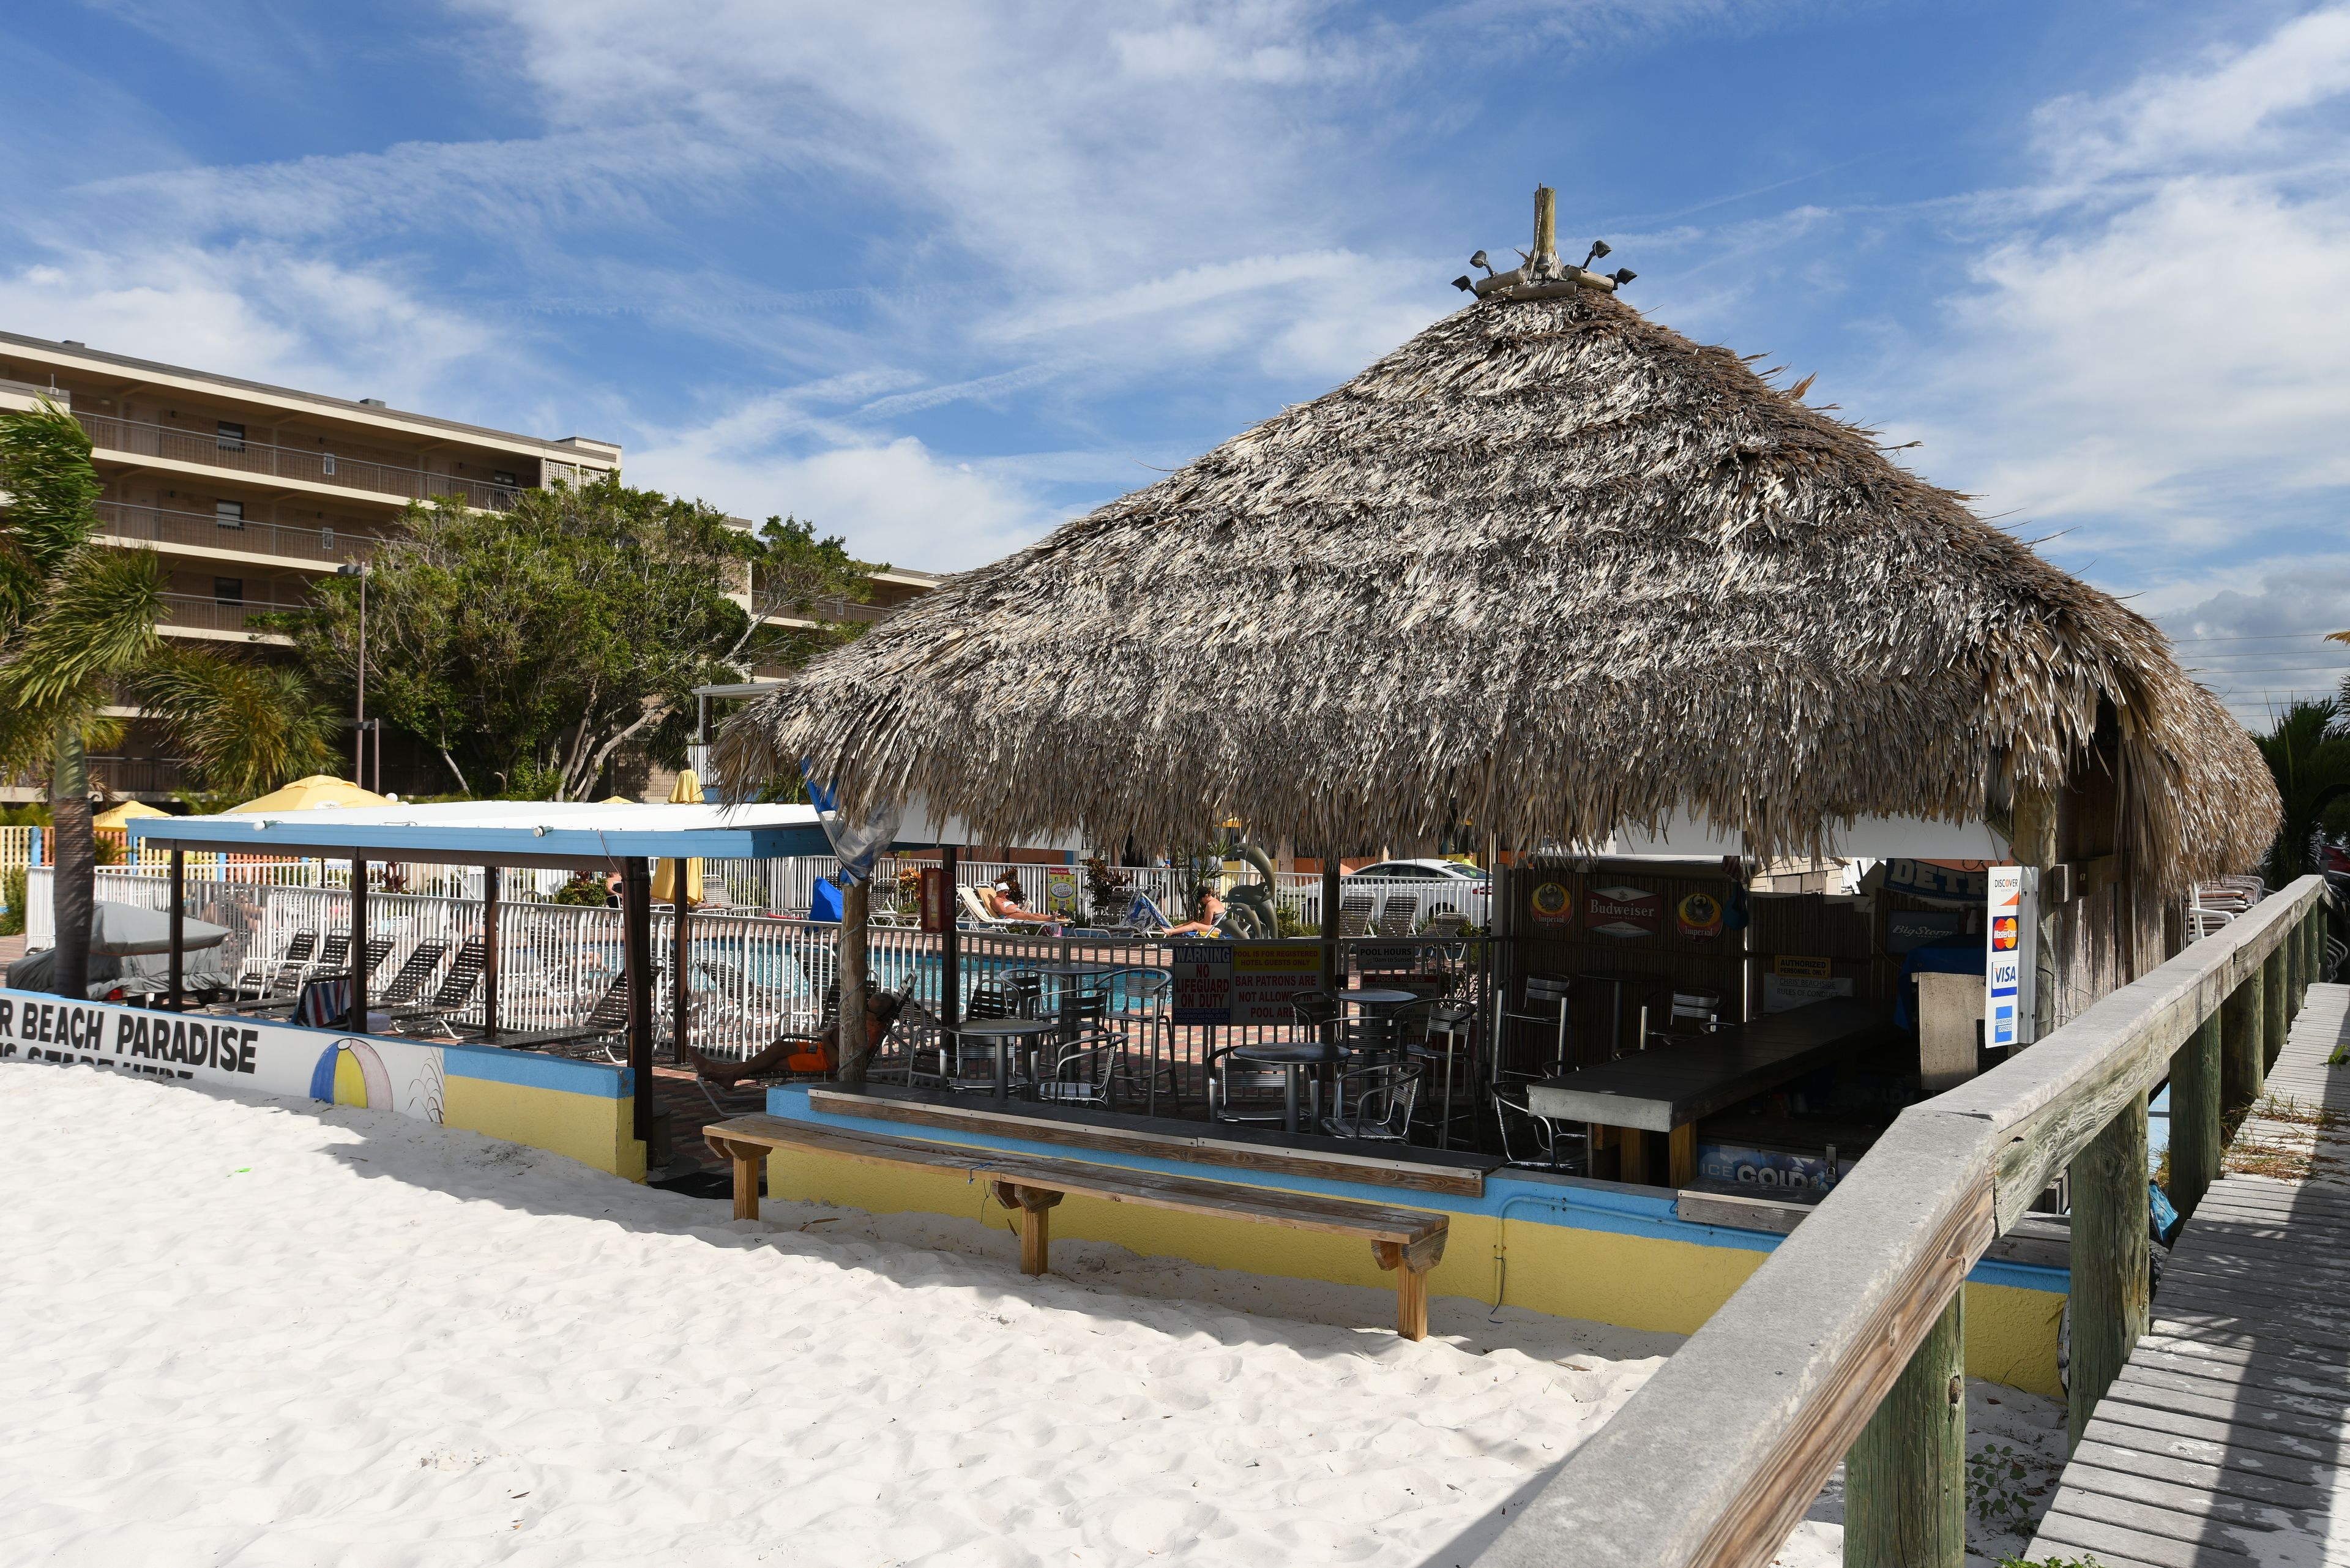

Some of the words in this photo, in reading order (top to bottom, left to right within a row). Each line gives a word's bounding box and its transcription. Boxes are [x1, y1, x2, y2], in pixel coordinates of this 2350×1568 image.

[1994, 879, 2018, 887] DISCOVER
[1591, 899, 1655, 917] Budweiser
[1538, 914, 1564, 927] Imperial
[1684, 925, 1713, 939] Imperial
[1993, 929, 2017, 939] MasterCard
[1176, 948, 1230, 963] WARNING
[1196, 963, 1210, 978] NO
[1780, 959, 1826, 968] AUTHORIZED
[1236, 976, 1253, 986] BAR
[1255, 976, 1296, 986] PATRONS
[1299, 976, 1317, 986] ARE
[1994, 966, 2016, 983] VISA
[1176, 979, 1230, 993] LIFEGUARD
[1801, 979, 1836, 988] BEACHSIDE
[1181, 994, 1195, 1008] ON
[1199, 994, 1225, 1008] DUTY
[1239, 991, 1257, 1002] NOT
[1251, 1007, 1274, 1018] POOL
[1277, 1007, 1295, 1018] ARE
[21, 1002, 105, 1051] BEACH
[116, 1014, 259, 1074] PARADISE
[1702, 1162, 1734, 1178] ICE
[1737, 1165, 1808, 1189] COLD
